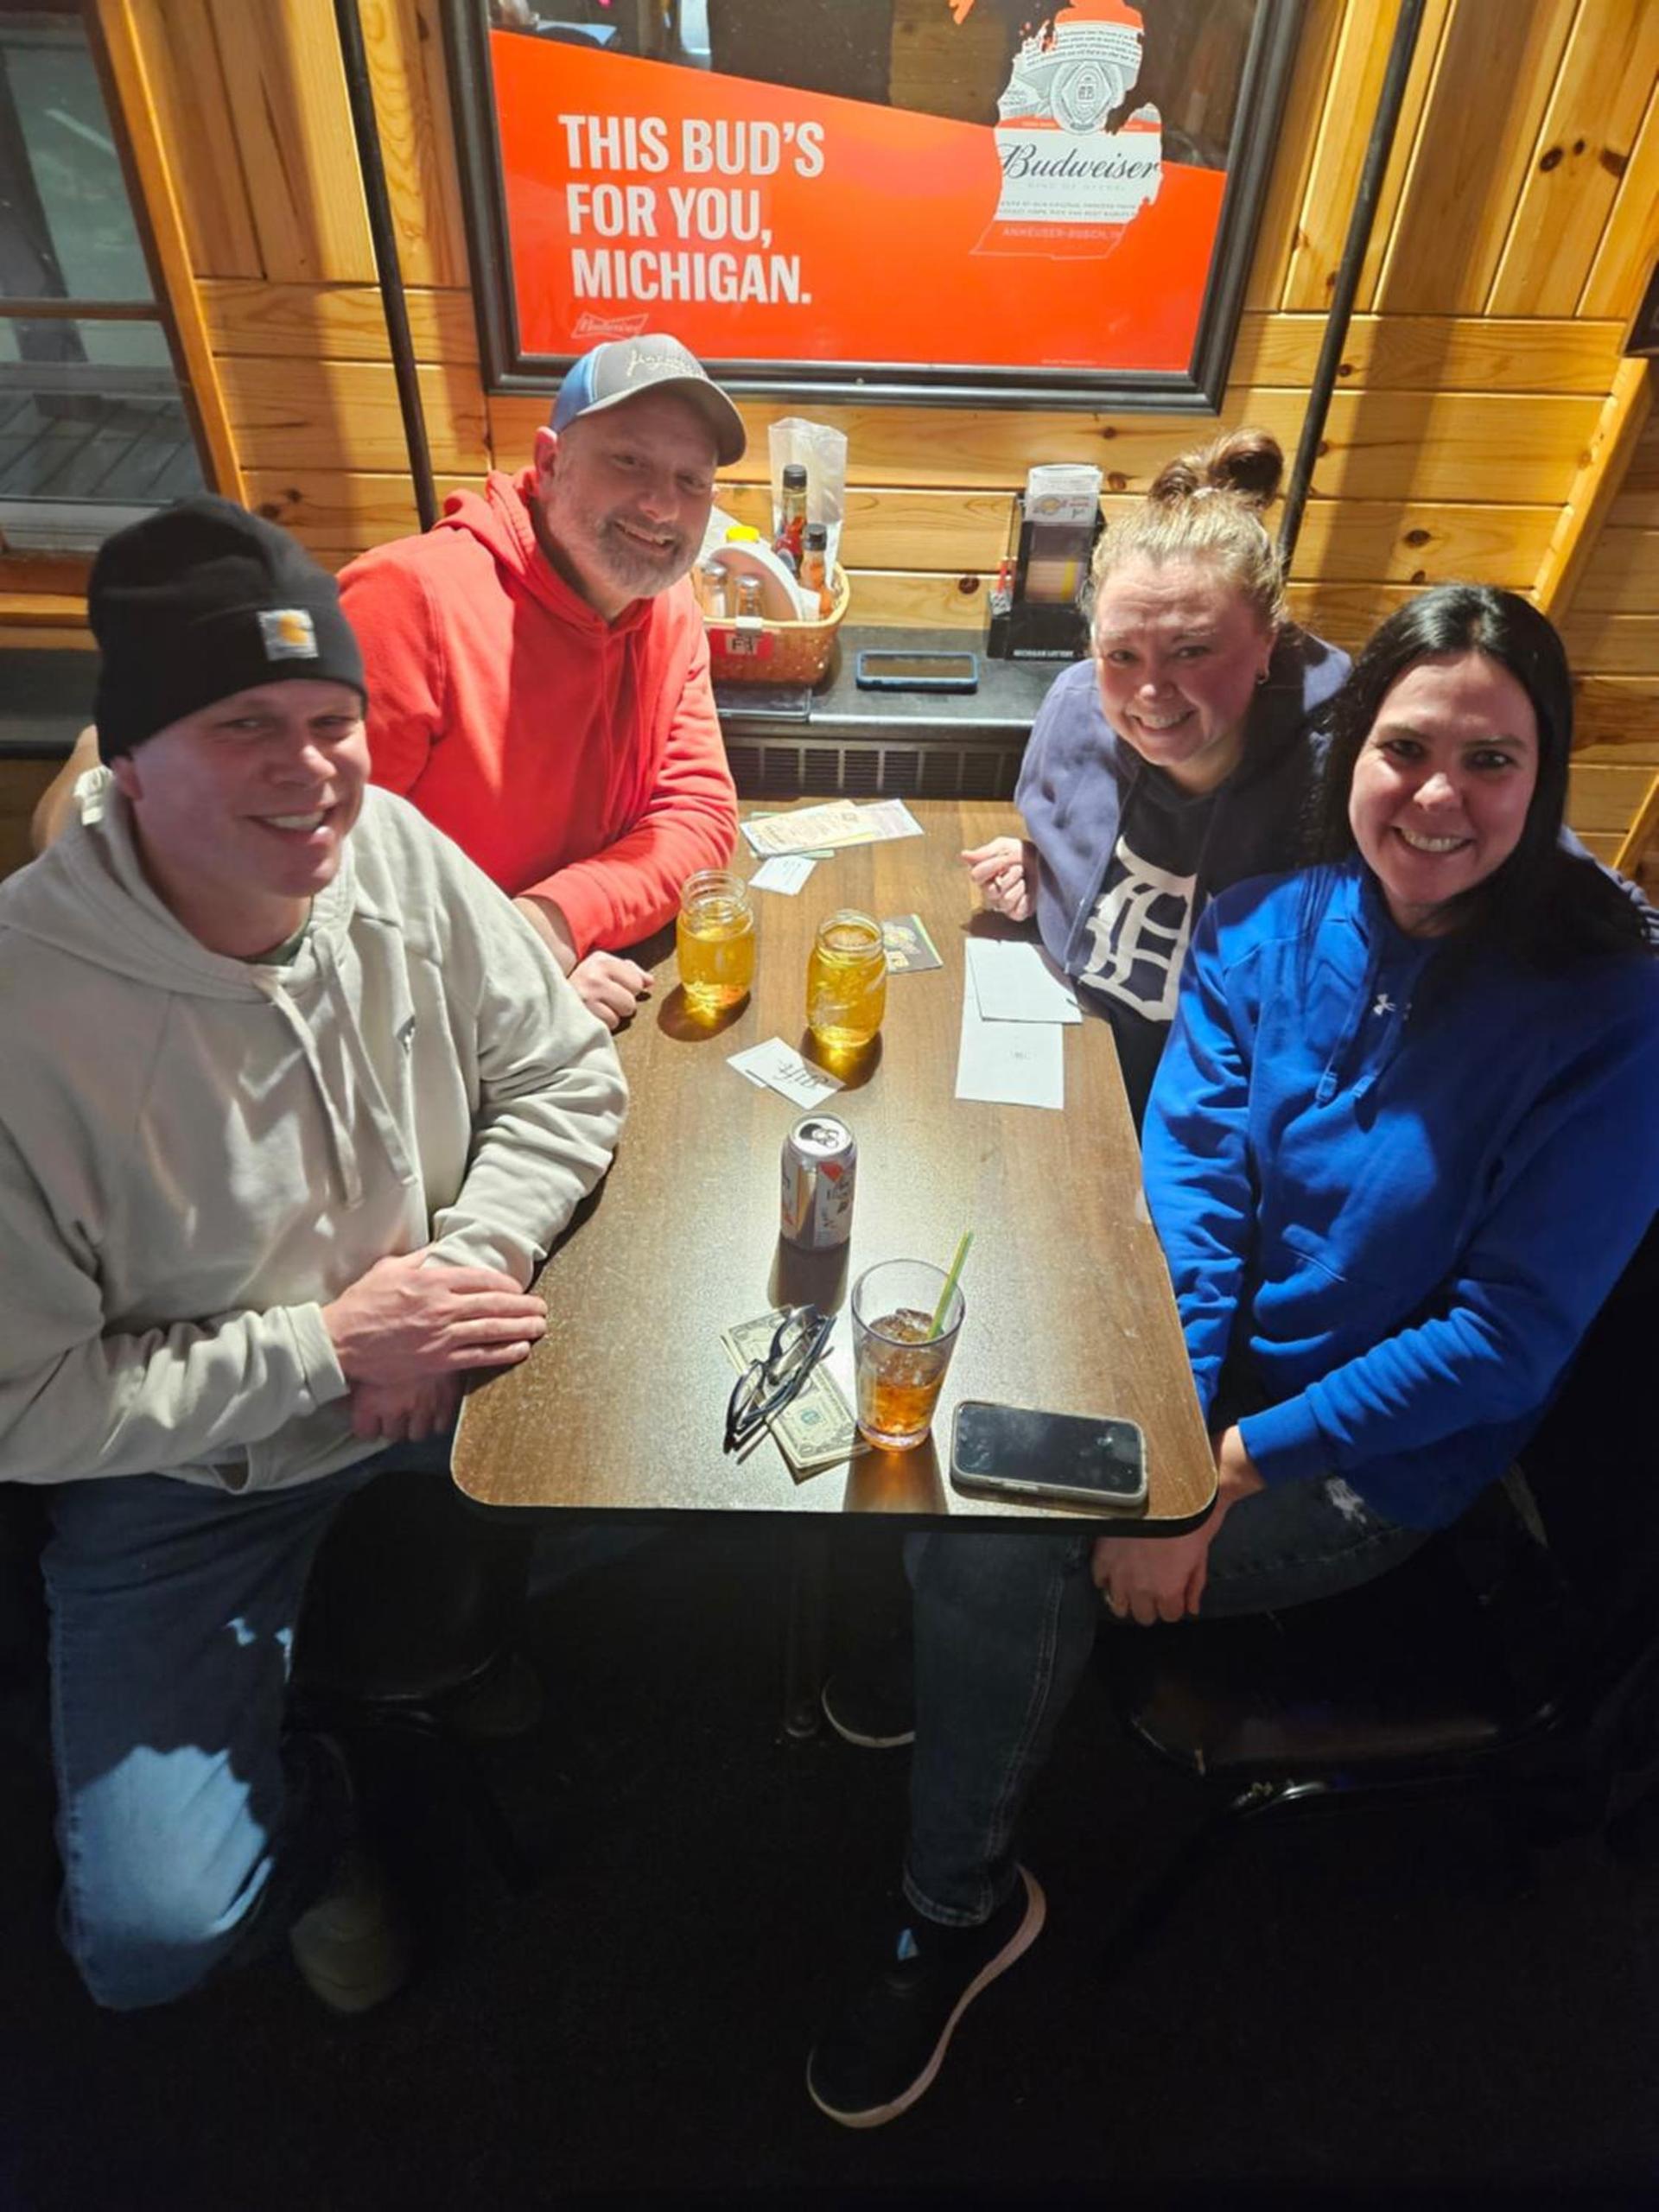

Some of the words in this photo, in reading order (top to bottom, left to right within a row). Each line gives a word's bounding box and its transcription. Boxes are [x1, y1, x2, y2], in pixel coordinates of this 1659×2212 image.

[557, 115, 670, 173] THIS
[681, 118, 825, 178] BUD'S
[999, 143, 1159, 180] Budweiser
[565, 183, 658, 238] FOR
[669, 187, 772, 249] YOU,
[570, 248, 811, 304] MICHIGAN.
